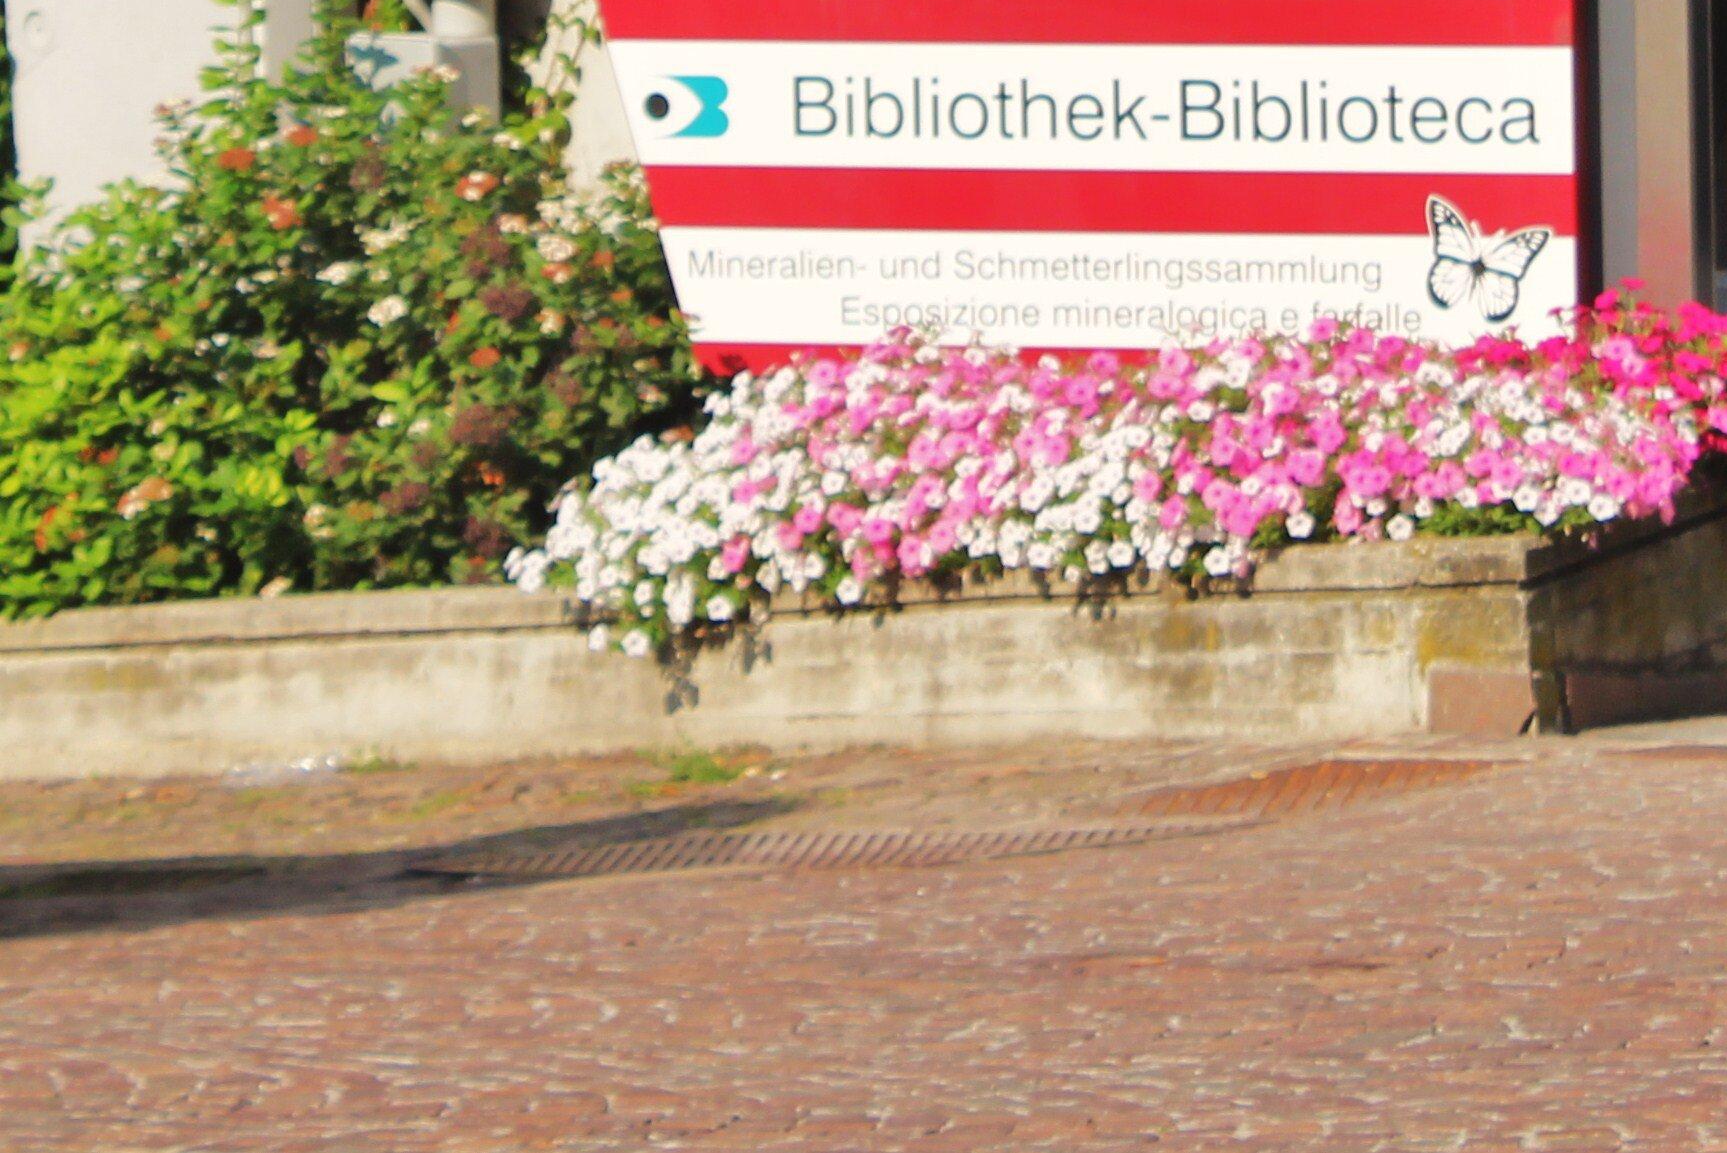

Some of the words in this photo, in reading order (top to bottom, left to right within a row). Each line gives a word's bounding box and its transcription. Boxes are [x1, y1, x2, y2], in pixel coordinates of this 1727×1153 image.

[792, 75, 1540, 144] Bibliothek-Biblioteca
[689, 249, 866, 279] Mineralien-
[879, 251, 941, 279] und
[954, 251, 1382, 292] Schmetterlingssammlung
[841, 297, 1039, 331] Esposizione
[1052, 300, 1266, 335] mineralogica
[1280, 311, 1298, 329] e
